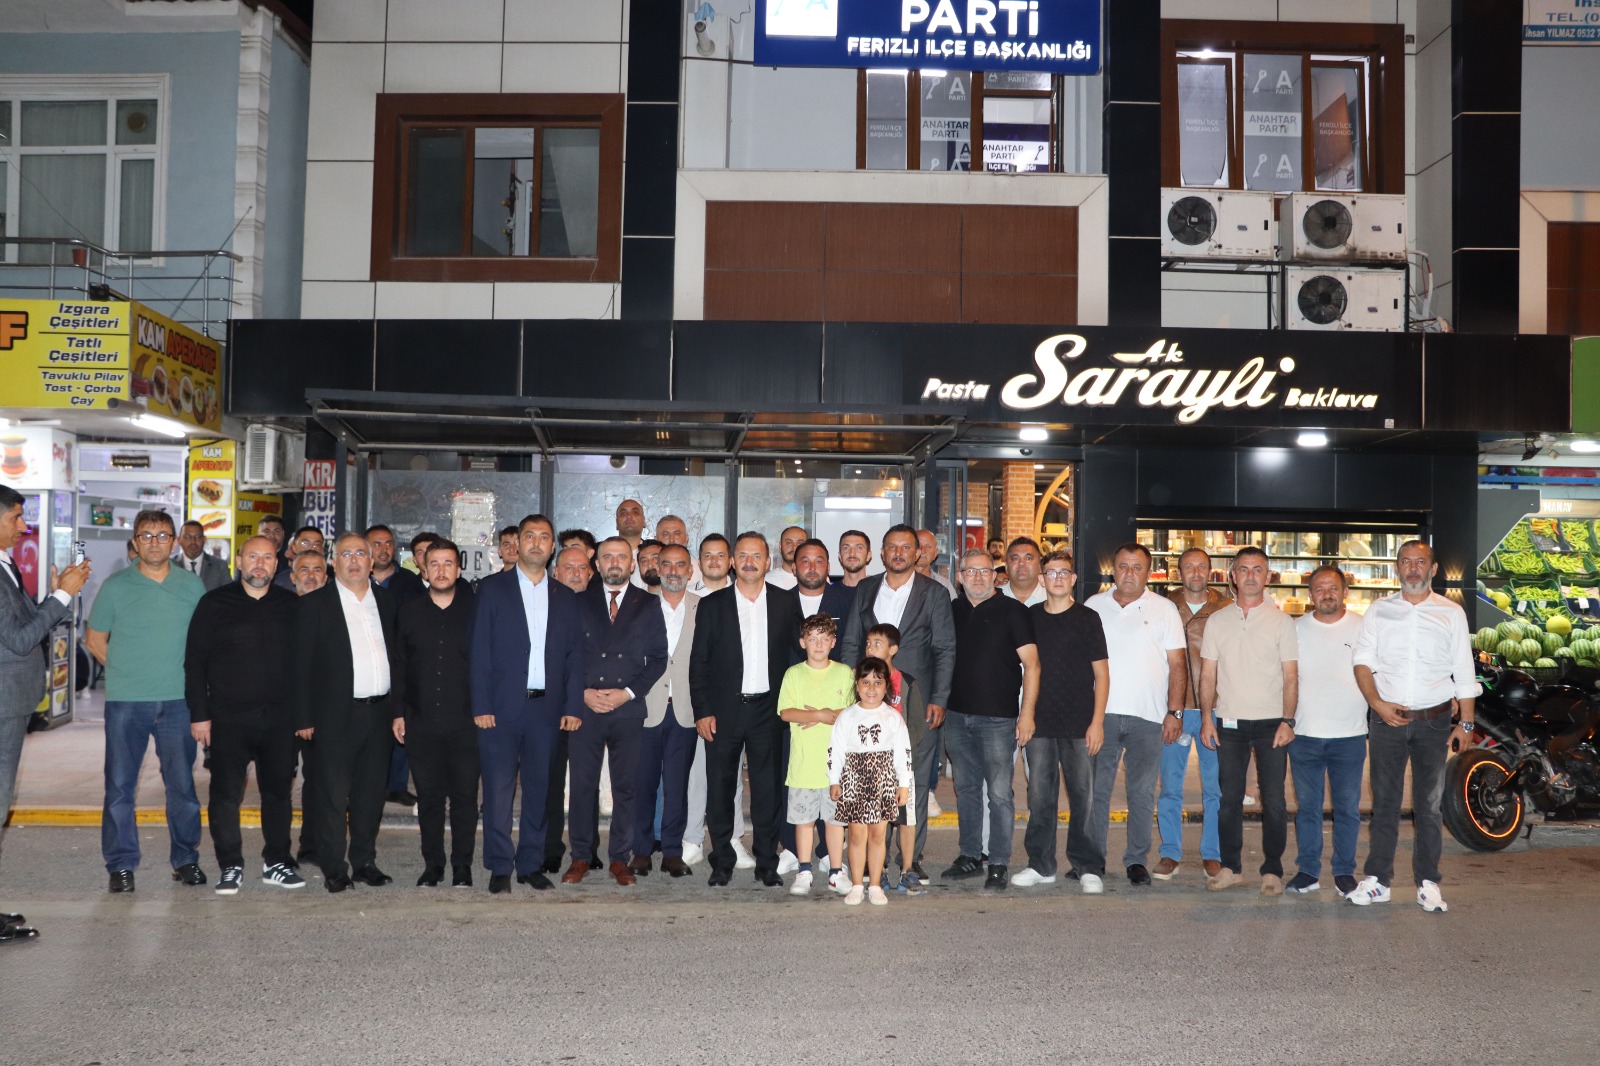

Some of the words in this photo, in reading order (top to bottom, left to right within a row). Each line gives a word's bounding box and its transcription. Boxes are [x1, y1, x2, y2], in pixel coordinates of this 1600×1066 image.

[1547, 28, 1575, 38] YILMAZ
[1577, 28, 1595, 38] 0532
[974, 40, 1091, 60] BAŞKANLIĞI
[1276, 70, 1292, 89] A
[949, 77, 965, 95] A
[922, 121, 969, 129] ANAHTAR
[1250, 115, 1297, 124] ANAHTAR
[983, 144, 1024, 152] ANAHTAR
[1276, 154, 1293, 173] A
[58, 303, 110, 316] Izgara
[49, 316, 119, 330] Çeşitleri
[138, 314, 165, 355] KAM
[67, 337, 102, 348] Tatlı
[48, 350, 118, 364] Çeşitleri
[41, 371, 91, 381] Tavuklu
[94, 372, 125, 381] Pilav
[44, 383, 73, 393] Tost
[84, 384, 121, 395] Çorba
[921, 377, 991, 400] Pasta
[70, 396, 95, 406] Çay
[1283, 387, 1379, 409] Baklava
[203, 448, 222, 458] KAM
[238, 500, 253, 512] KAM
[1543, 502, 1572, 513] MANAV
